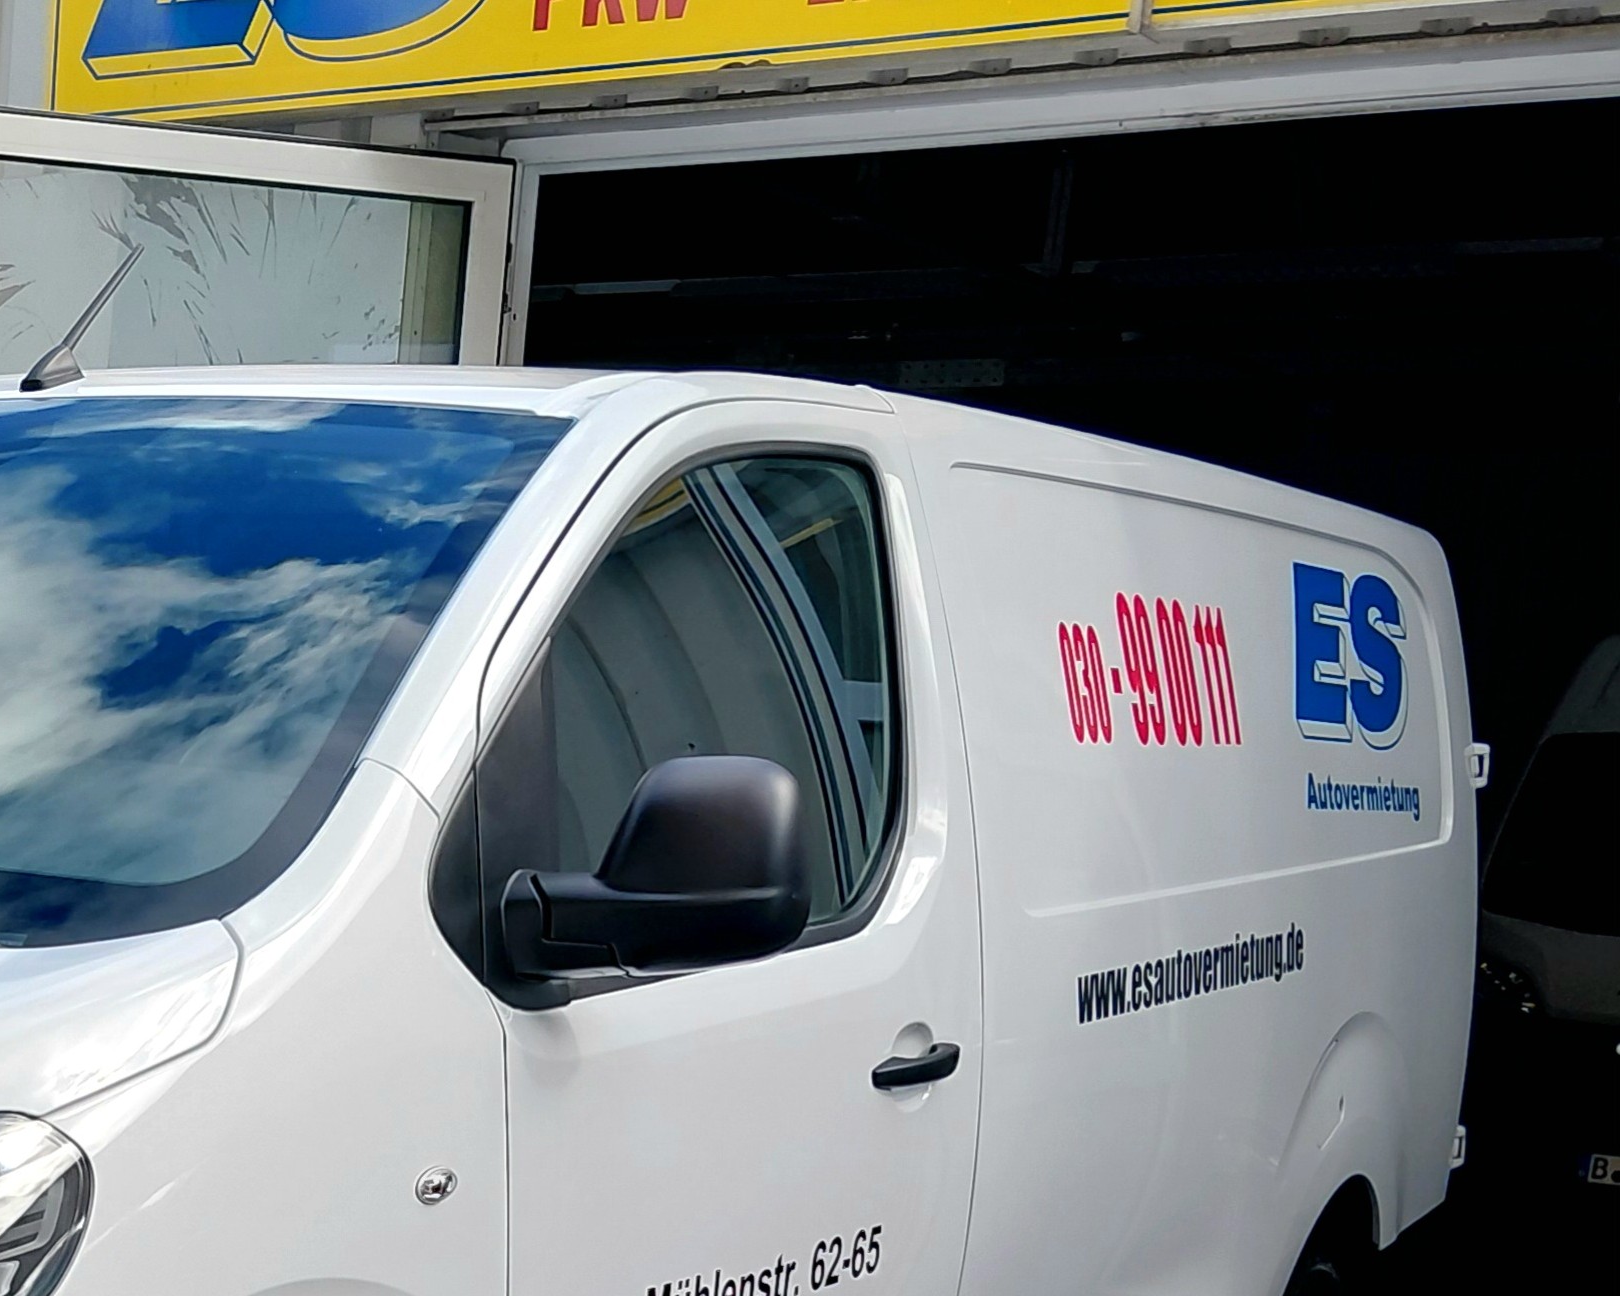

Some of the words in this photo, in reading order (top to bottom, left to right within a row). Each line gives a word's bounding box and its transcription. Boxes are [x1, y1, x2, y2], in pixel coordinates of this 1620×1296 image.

[1057, 620, 1113, 744] 030
[1292, 561, 1409, 751] ES
[1306, 772, 1421, 822] Autovermietung
[1077, 922, 1305, 1025] www.esautovermietung.de
[809, 1224, 883, 1292] 62-65
